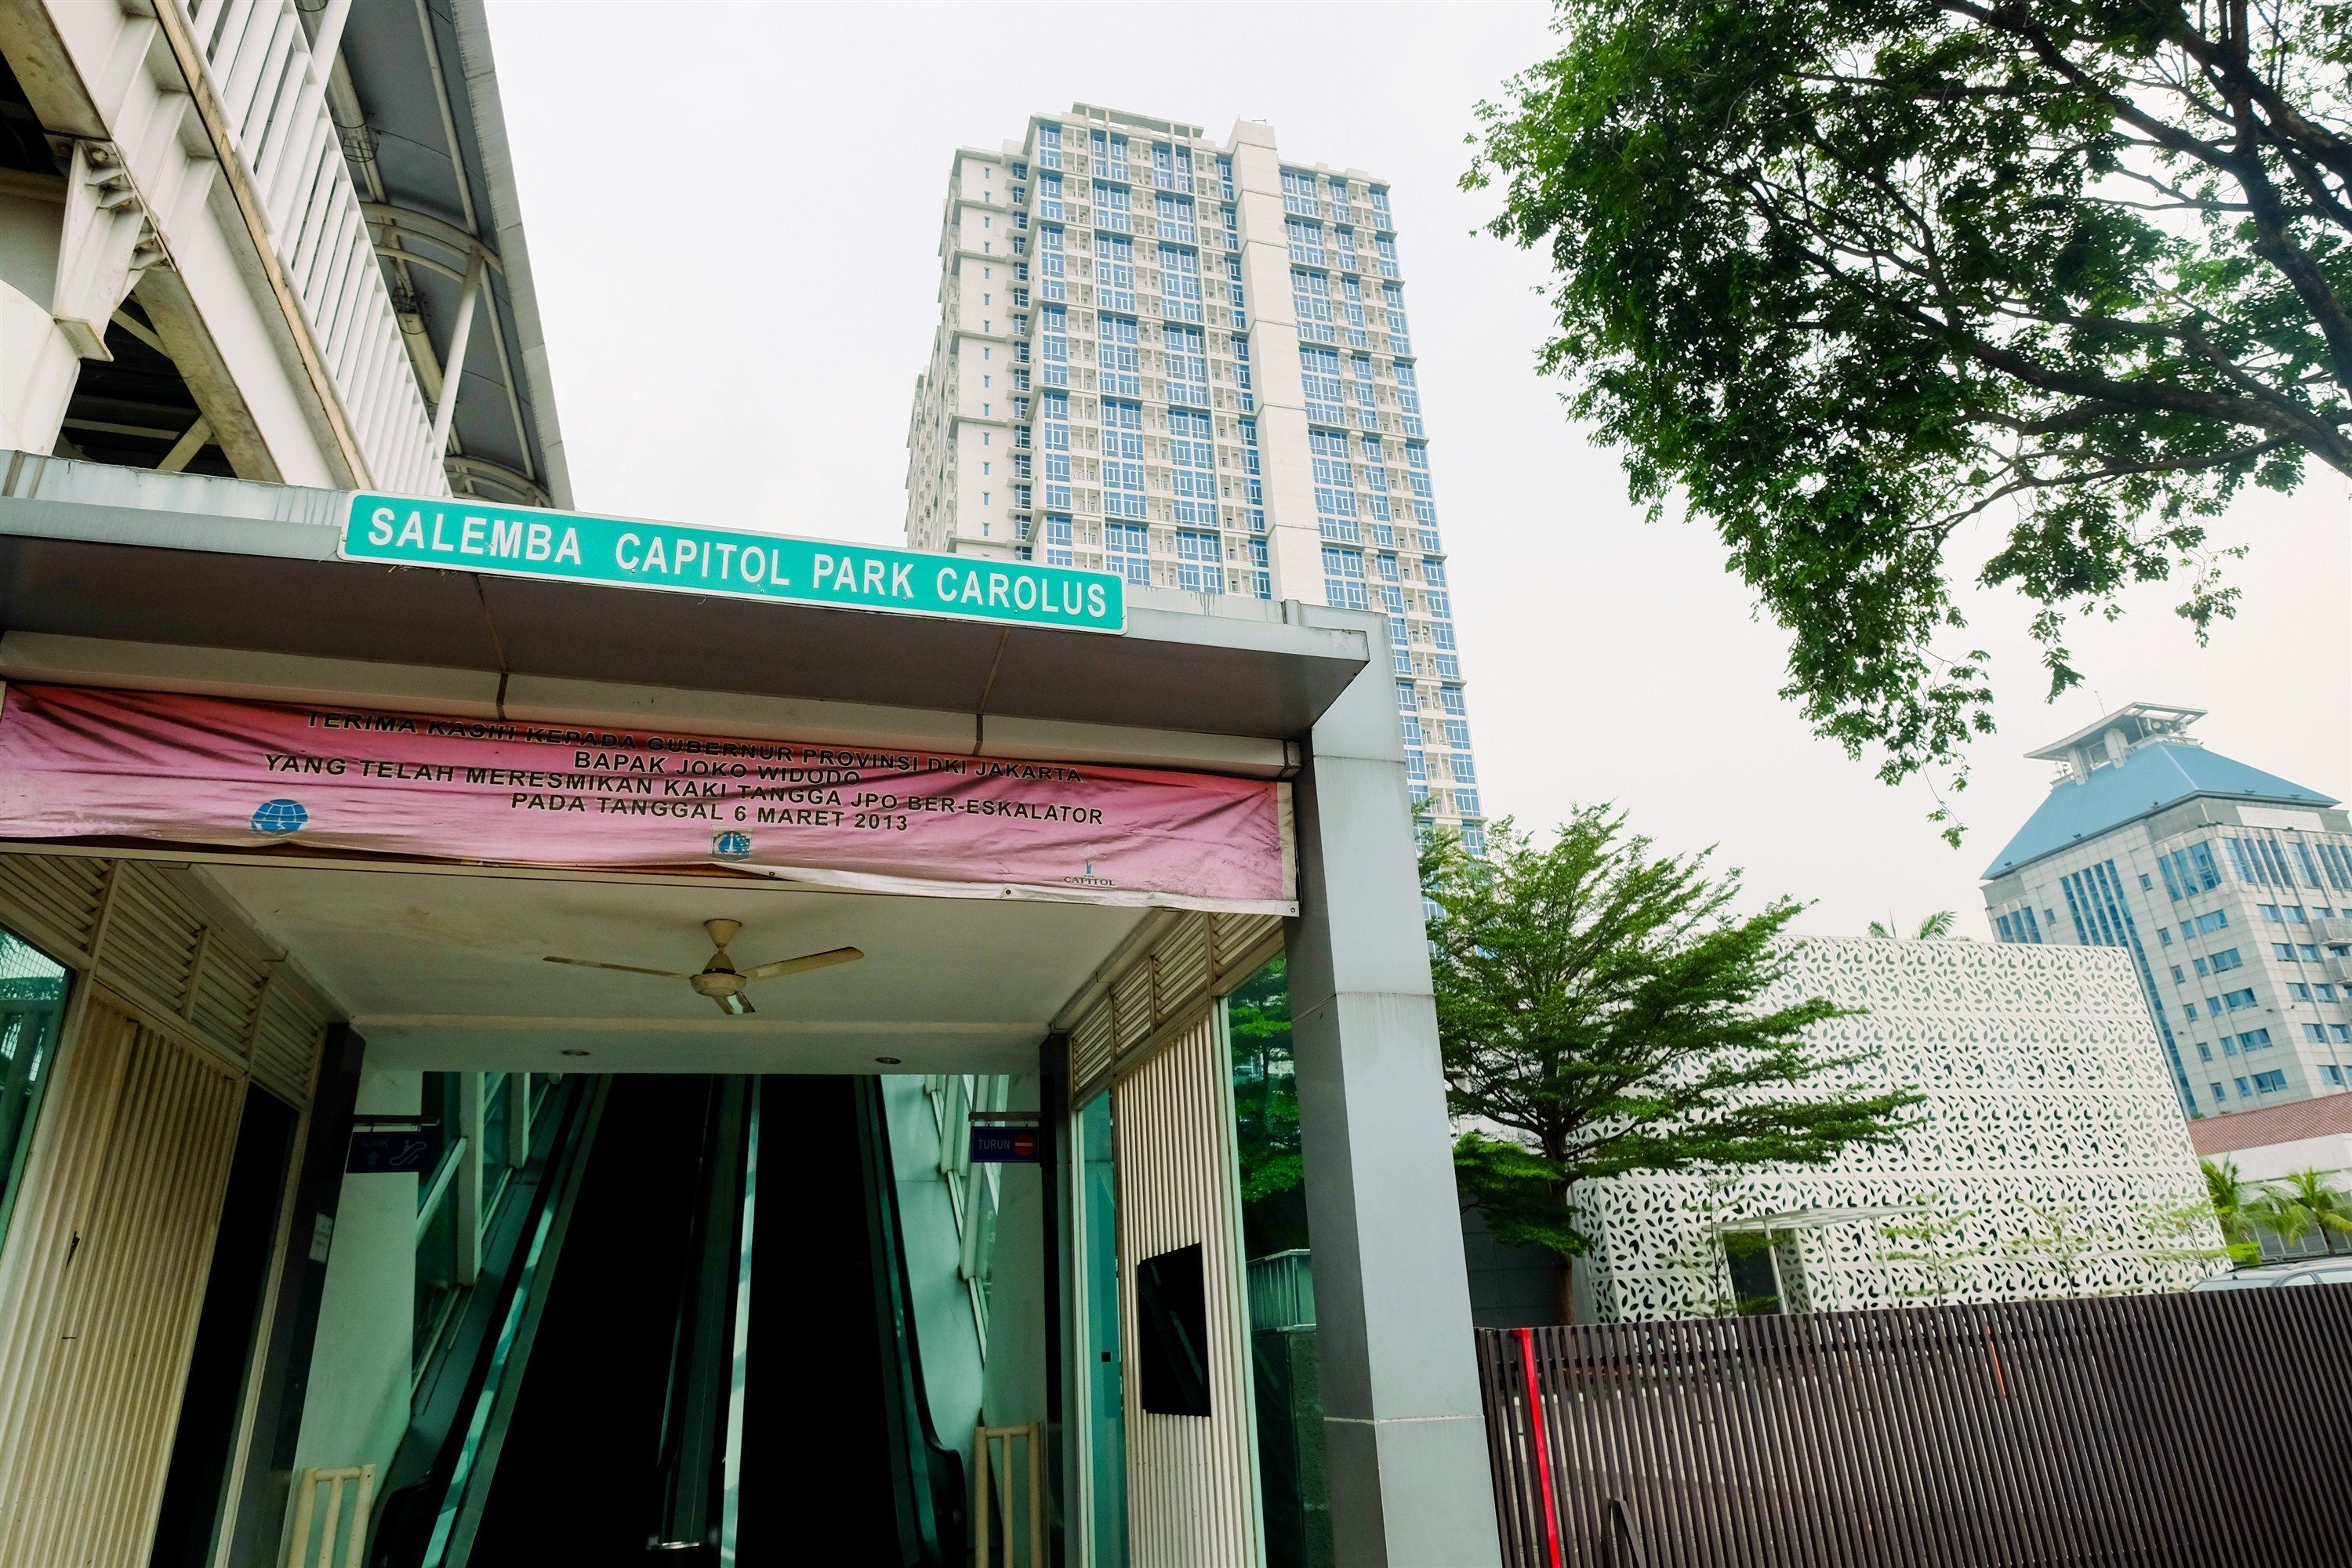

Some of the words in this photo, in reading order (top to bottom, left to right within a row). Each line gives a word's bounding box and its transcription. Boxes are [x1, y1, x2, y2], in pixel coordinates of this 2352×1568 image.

[368, 506, 582, 565] SALEMBA
[615, 532, 789, 586] CAPITOL
[813, 554, 914, 598] PARK
[937, 567, 1106, 617] CAROLUS
[307, 710, 416, 734] TERIMA
[428, 720, 516, 741] KASIH
[526, 728, 635, 750] KEPADA
[647, 736, 793, 763] GUBERNUR
[802, 748, 919, 772] PROVINSI
[927, 757, 967, 775] DKI
[975, 761, 1083, 783] JAKARTA
[573, 750, 666, 775] BAPAK
[676, 758, 746, 779] JOKO
[757, 765, 861, 786] WIDODO
[264, 753, 347, 775] YANG
[359, 759, 453, 782] TELAH
[466, 766, 652, 796] MERESMIKAN
[664, 779, 726, 799] KAKI
[737, 784, 841, 807] TANGGA
[850, 793, 898, 811] JPO
[908, 796, 1103, 825] BER-ESKALATOR
[511, 791, 585, 812] PADA
[597, 797, 724, 822] TANGGAL
[734, 805, 746, 822] 6
[757, 807, 845, 828] MARET
[855, 812, 908, 832] 2013
[1064, 876, 1116, 886] CAPITOL
[978, 1139, 1011, 1150] TURUN
